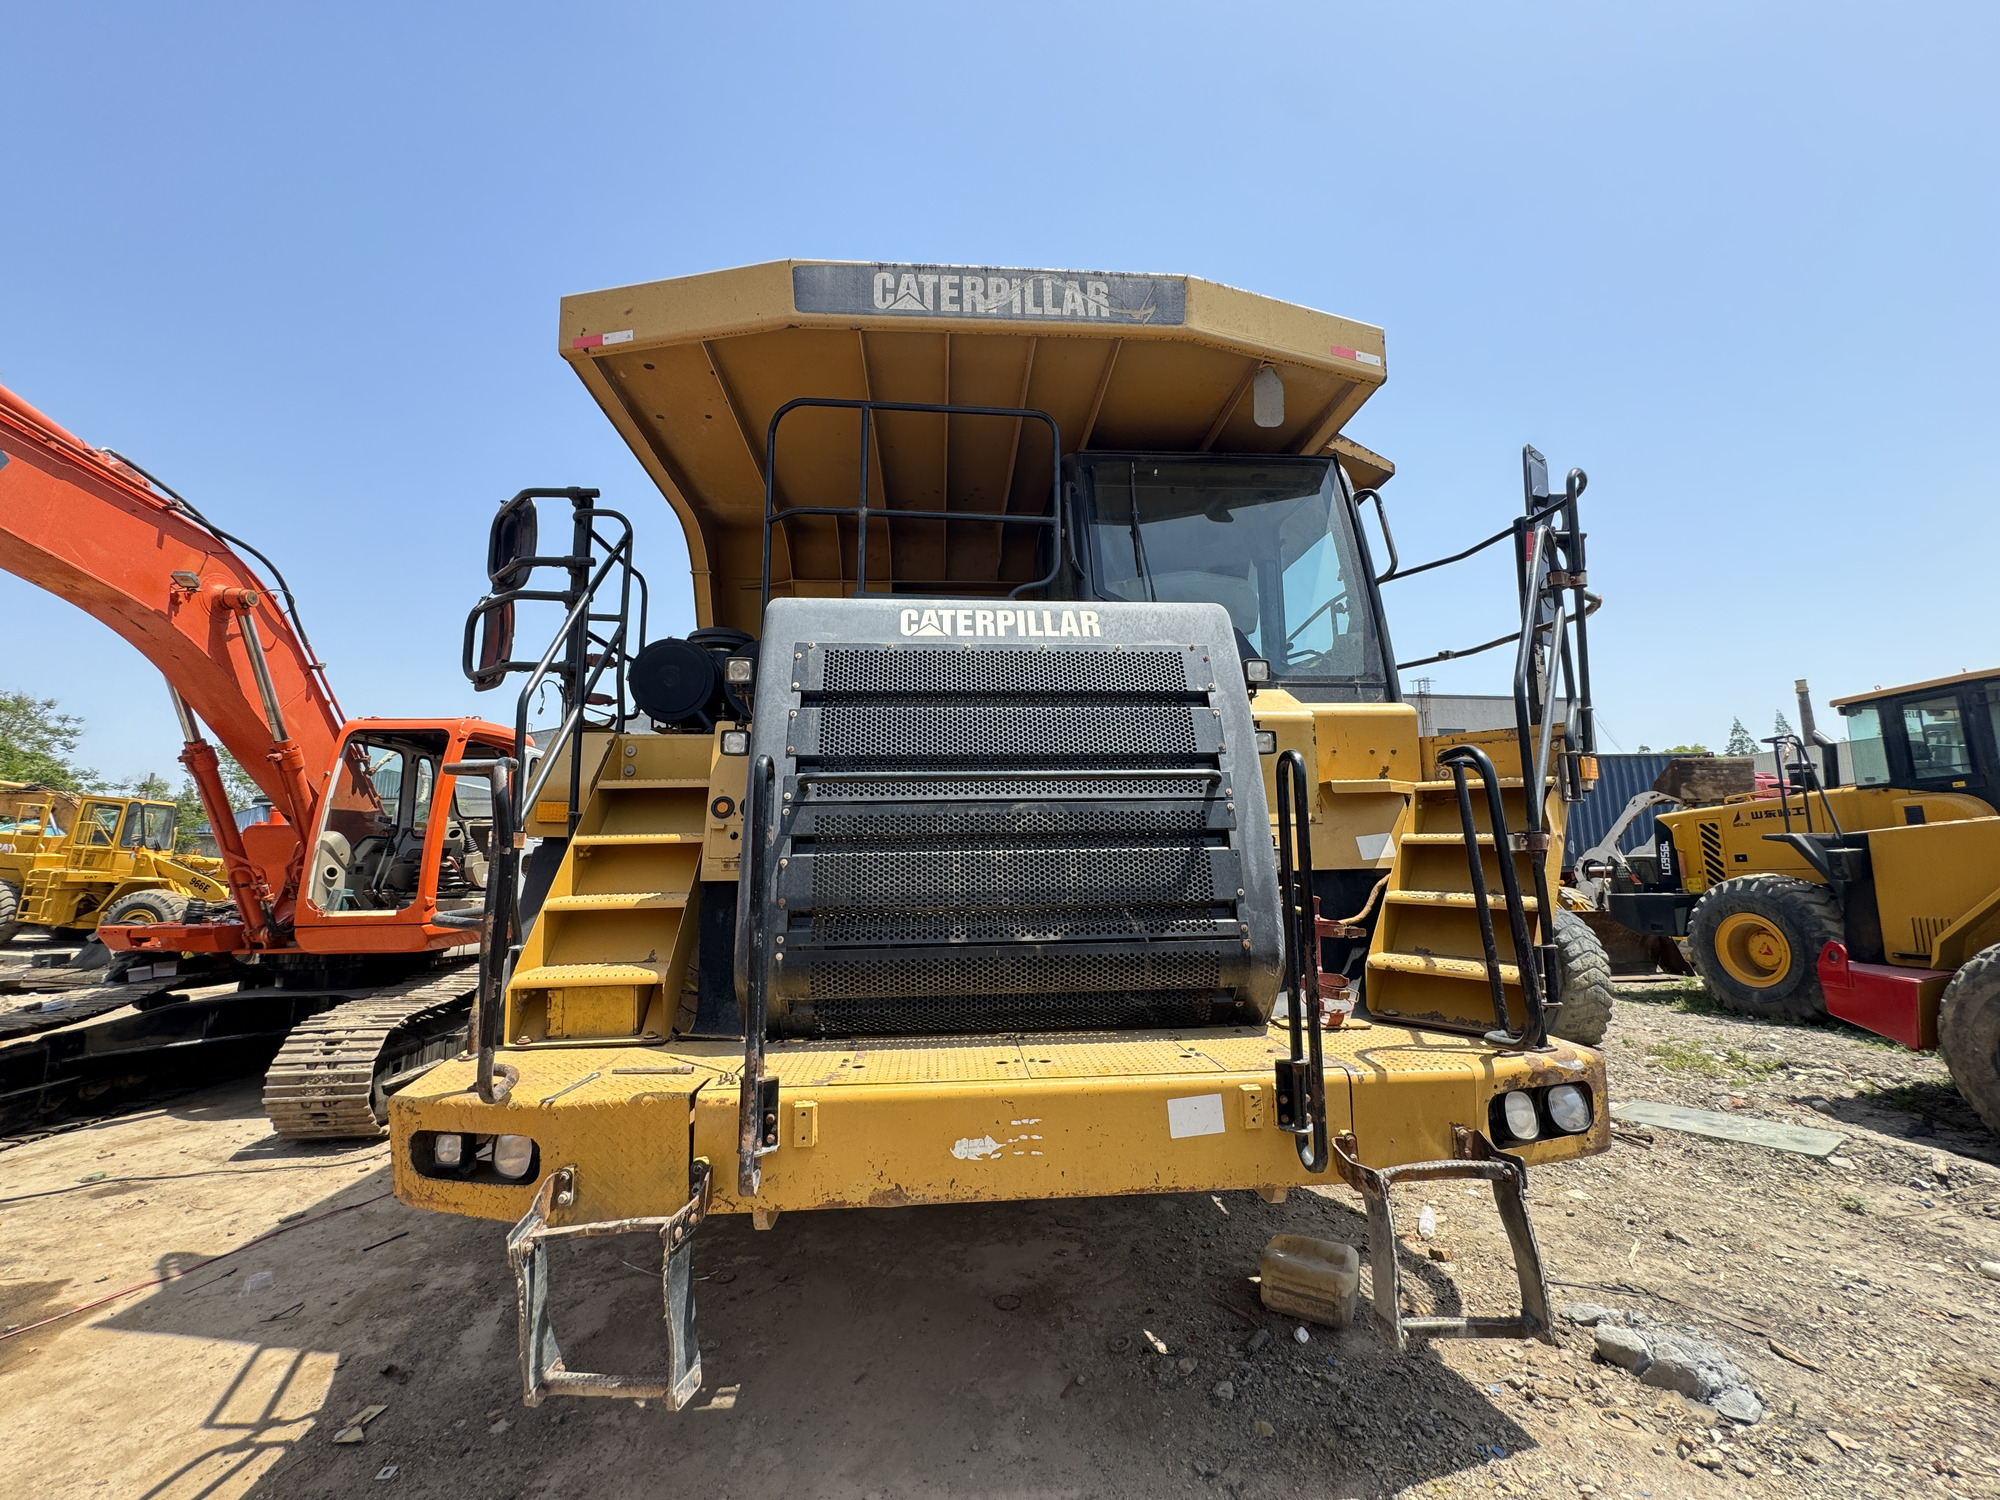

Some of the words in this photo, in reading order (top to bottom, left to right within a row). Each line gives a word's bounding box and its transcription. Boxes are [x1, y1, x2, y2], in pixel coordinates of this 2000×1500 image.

[873, 272, 1110, 317] CATERPILLAR
[900, 608, 1101, 638] CATERPILLAR
[1659, 840, 1672, 876] LG956L
[189, 877, 211, 893] 966E
